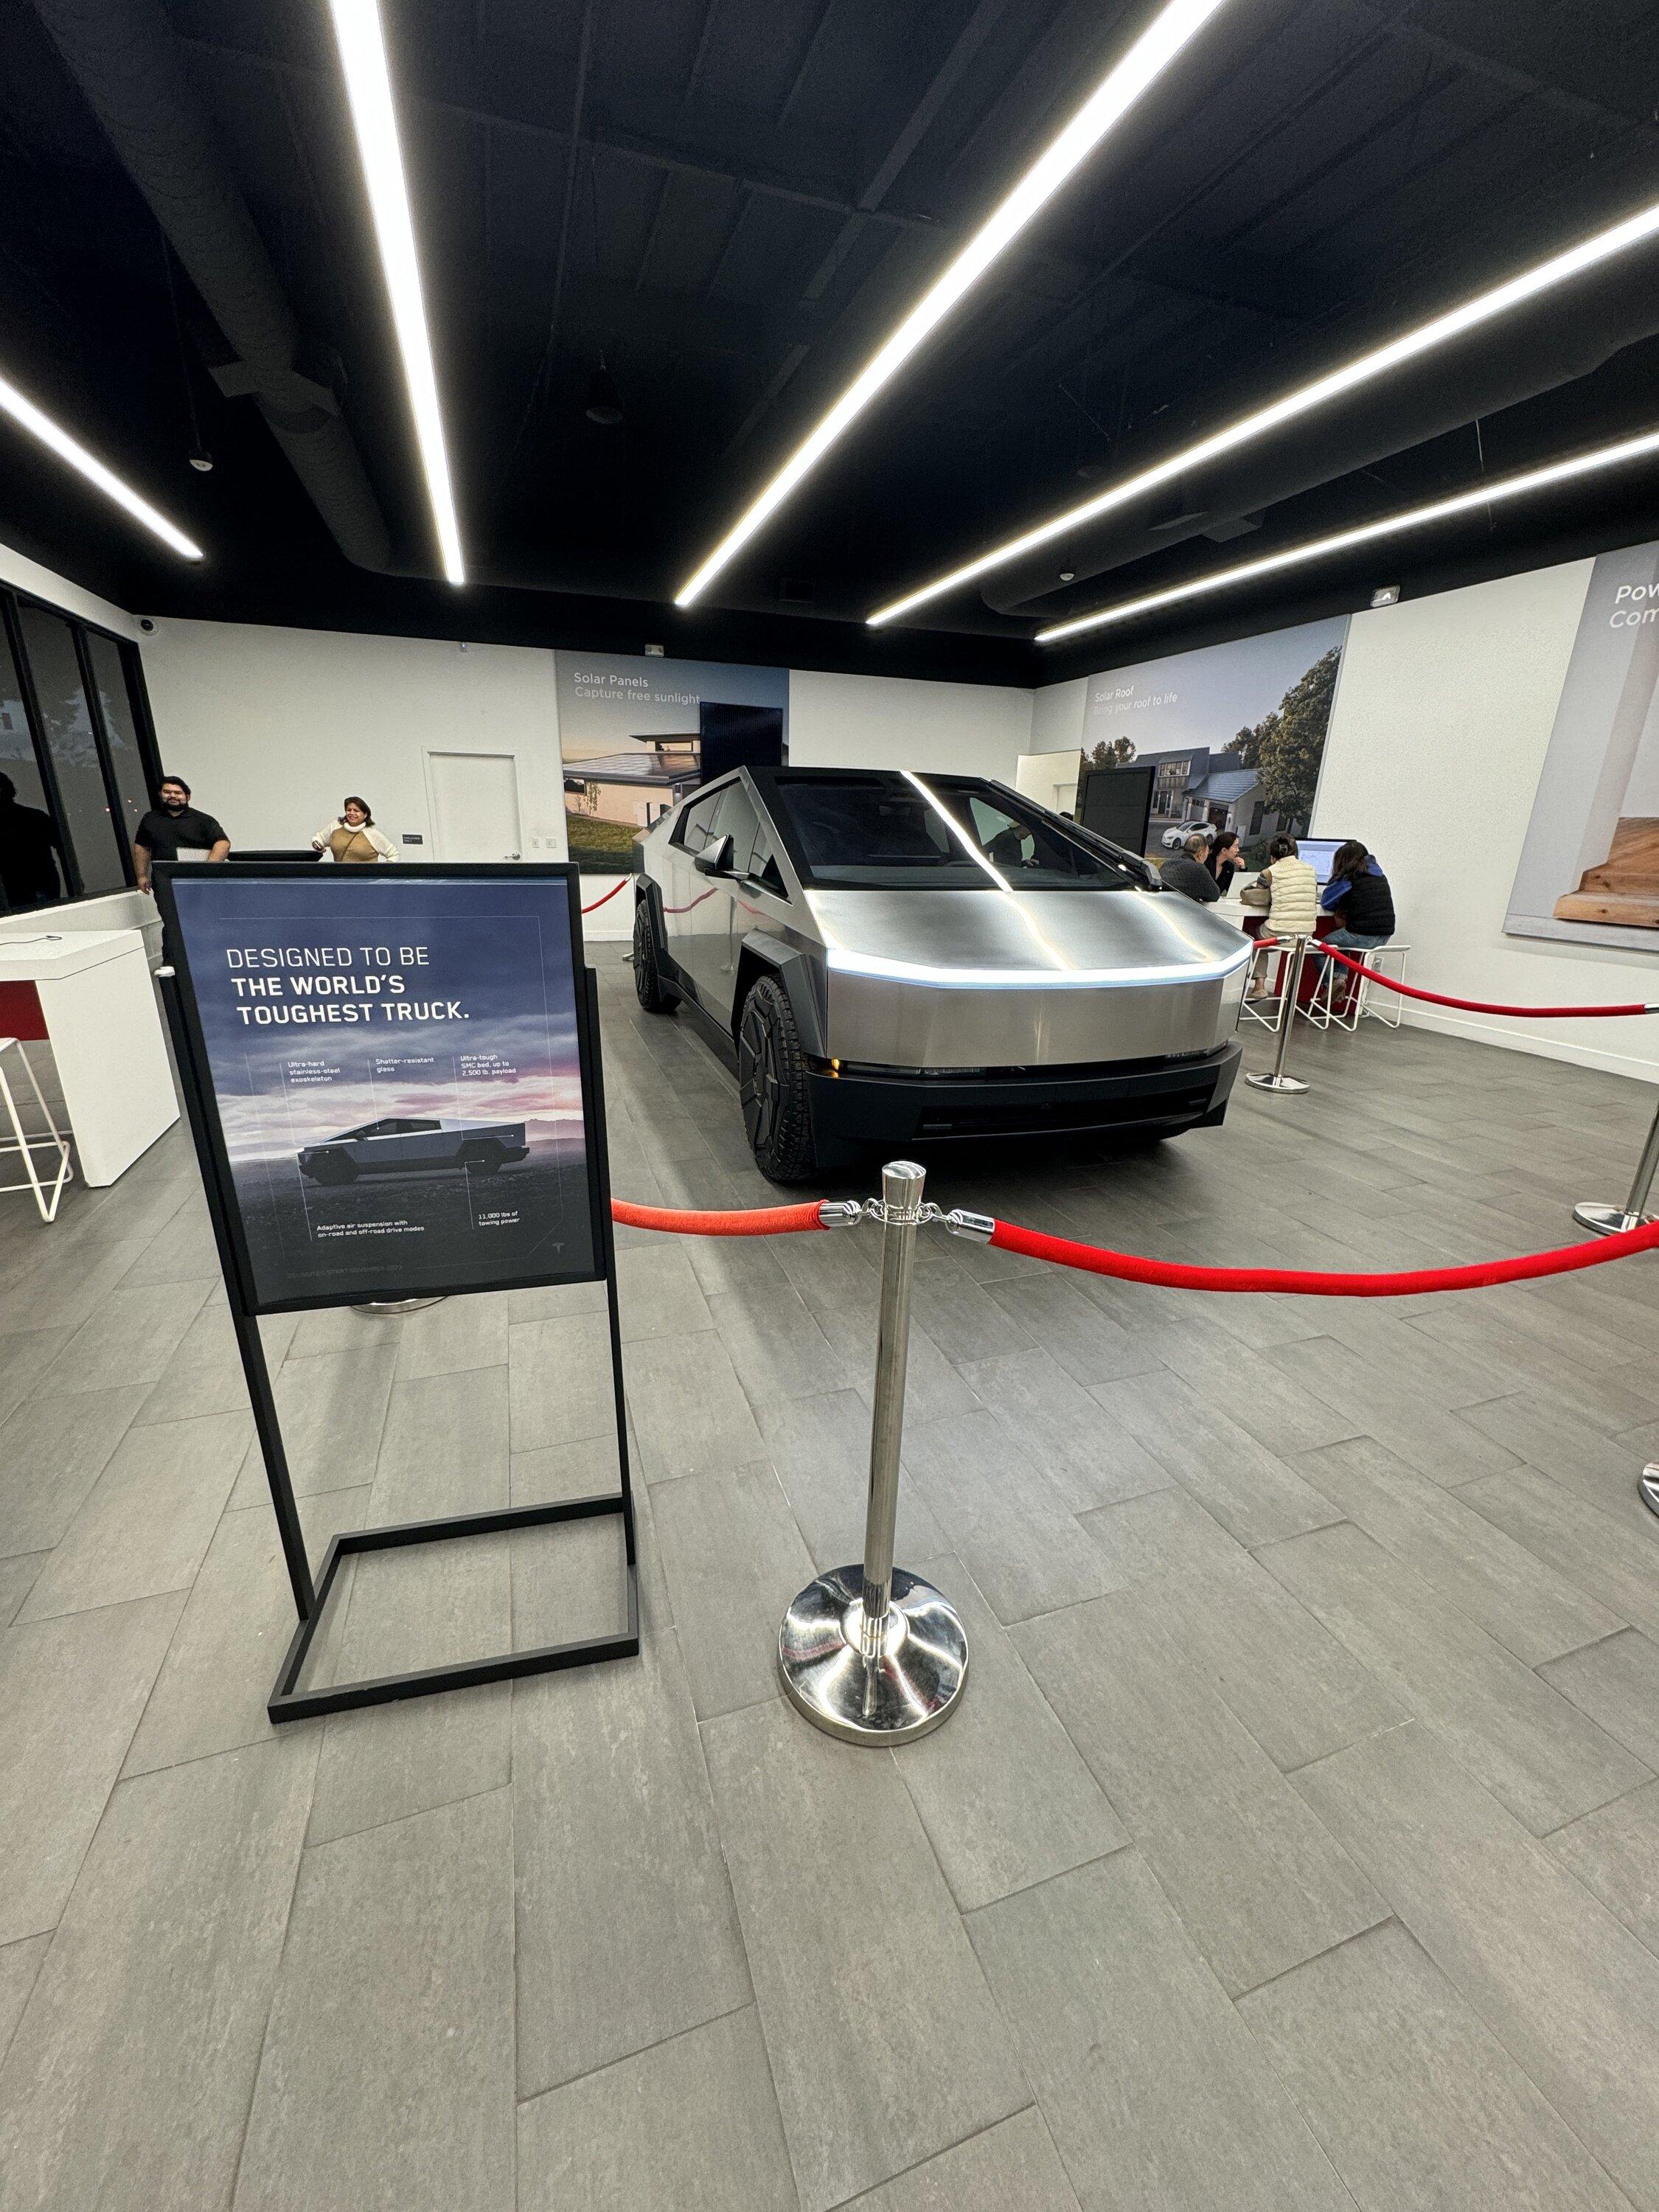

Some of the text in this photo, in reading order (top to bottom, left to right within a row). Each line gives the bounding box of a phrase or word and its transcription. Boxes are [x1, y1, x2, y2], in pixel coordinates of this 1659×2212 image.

[574, 672, 649, 688] Solar Panels
[574, 686, 700, 706] Capture free sunlight
[1095, 685, 1134, 702] Solar Roof
[1115, 702, 1132, 714] your
[1133, 695, 1151, 709] roof
[1152, 695, 1162, 706] to
[1164, 692, 1178, 703] life
[226, 947, 430, 968] DESIGNED TO BE
[231, 975, 406, 997] THE WORLD'S
[237, 1001, 470, 1025] TOUGHEST TRUCK.
[375, 1057, 434, 1065] Shatter-resistant
[289, 1068, 341, 1076] stainless-steel
[492, 1068, 516, 1076] payload
[316, 1224, 345, 1232] Adaptive
[357, 1221, 393, 1229] suspension
[318, 1230, 344, 1238] on-road
